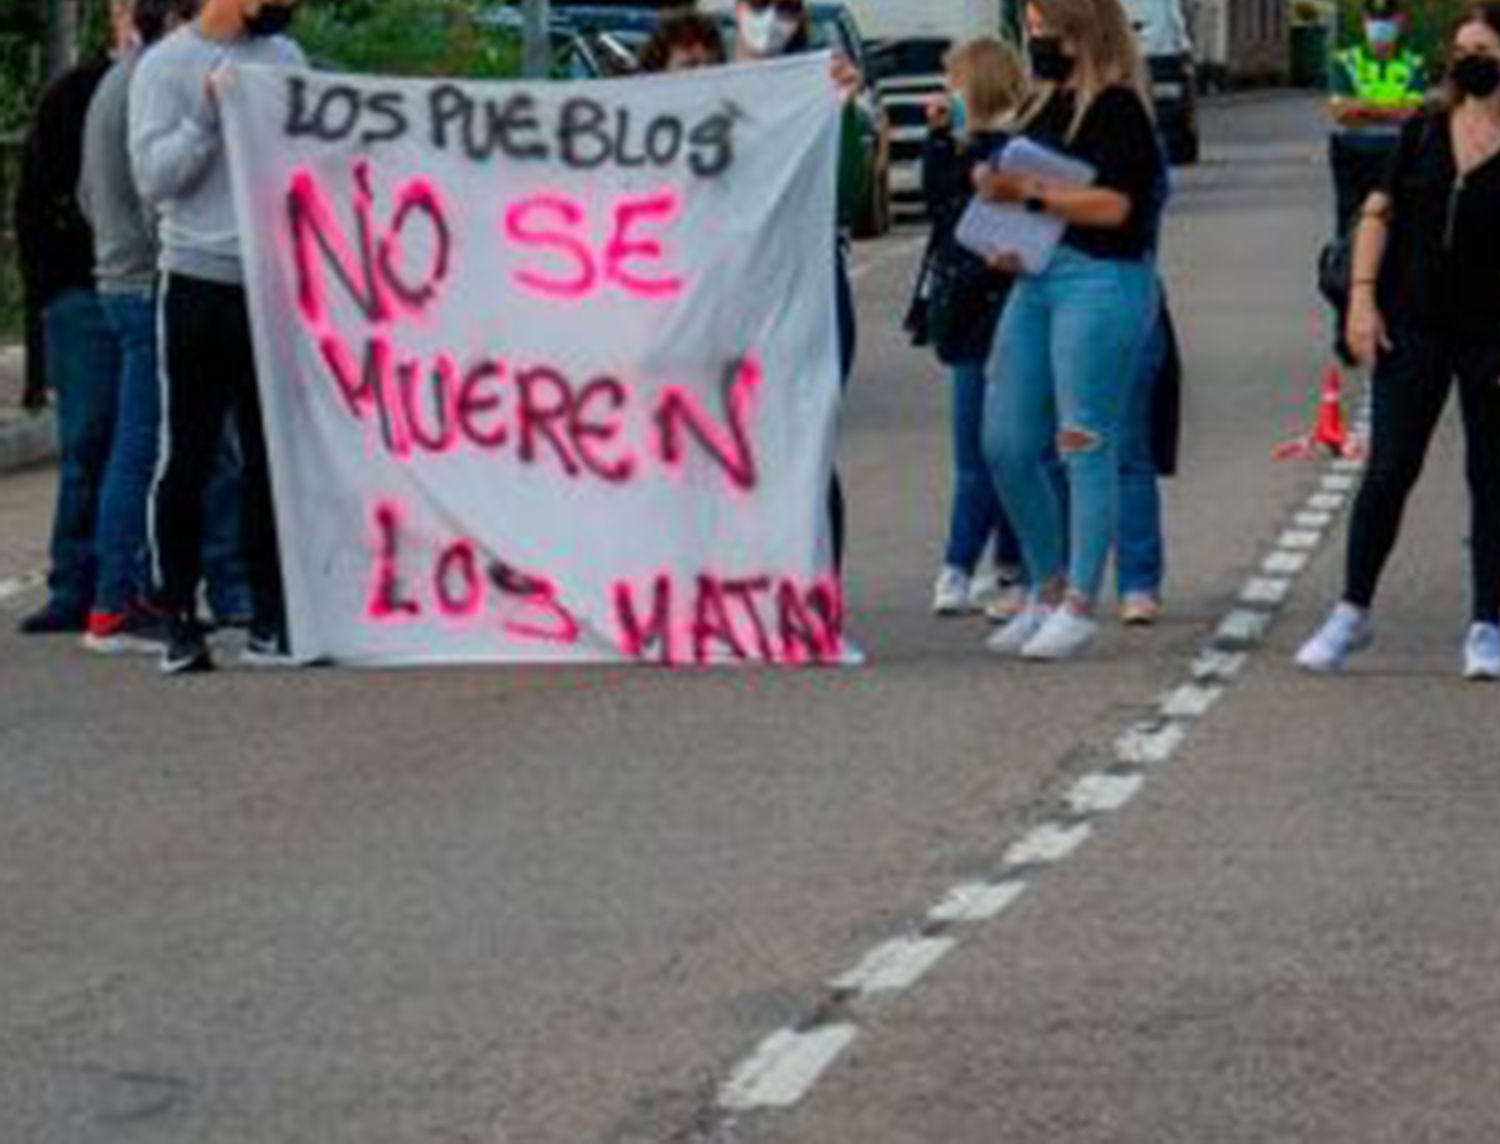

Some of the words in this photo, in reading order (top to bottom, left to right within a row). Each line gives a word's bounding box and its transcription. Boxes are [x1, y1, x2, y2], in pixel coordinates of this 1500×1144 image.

[285, 77, 408, 143] LOS
[428, 85, 742, 177] PUEBLOS
[286, 161, 451, 324] NO
[503, 192, 684, 297] SE
[318, 334, 762, 491] MUEREN
[368, 499, 580, 644] LOS
[608, 572, 843, 668] MATAN
